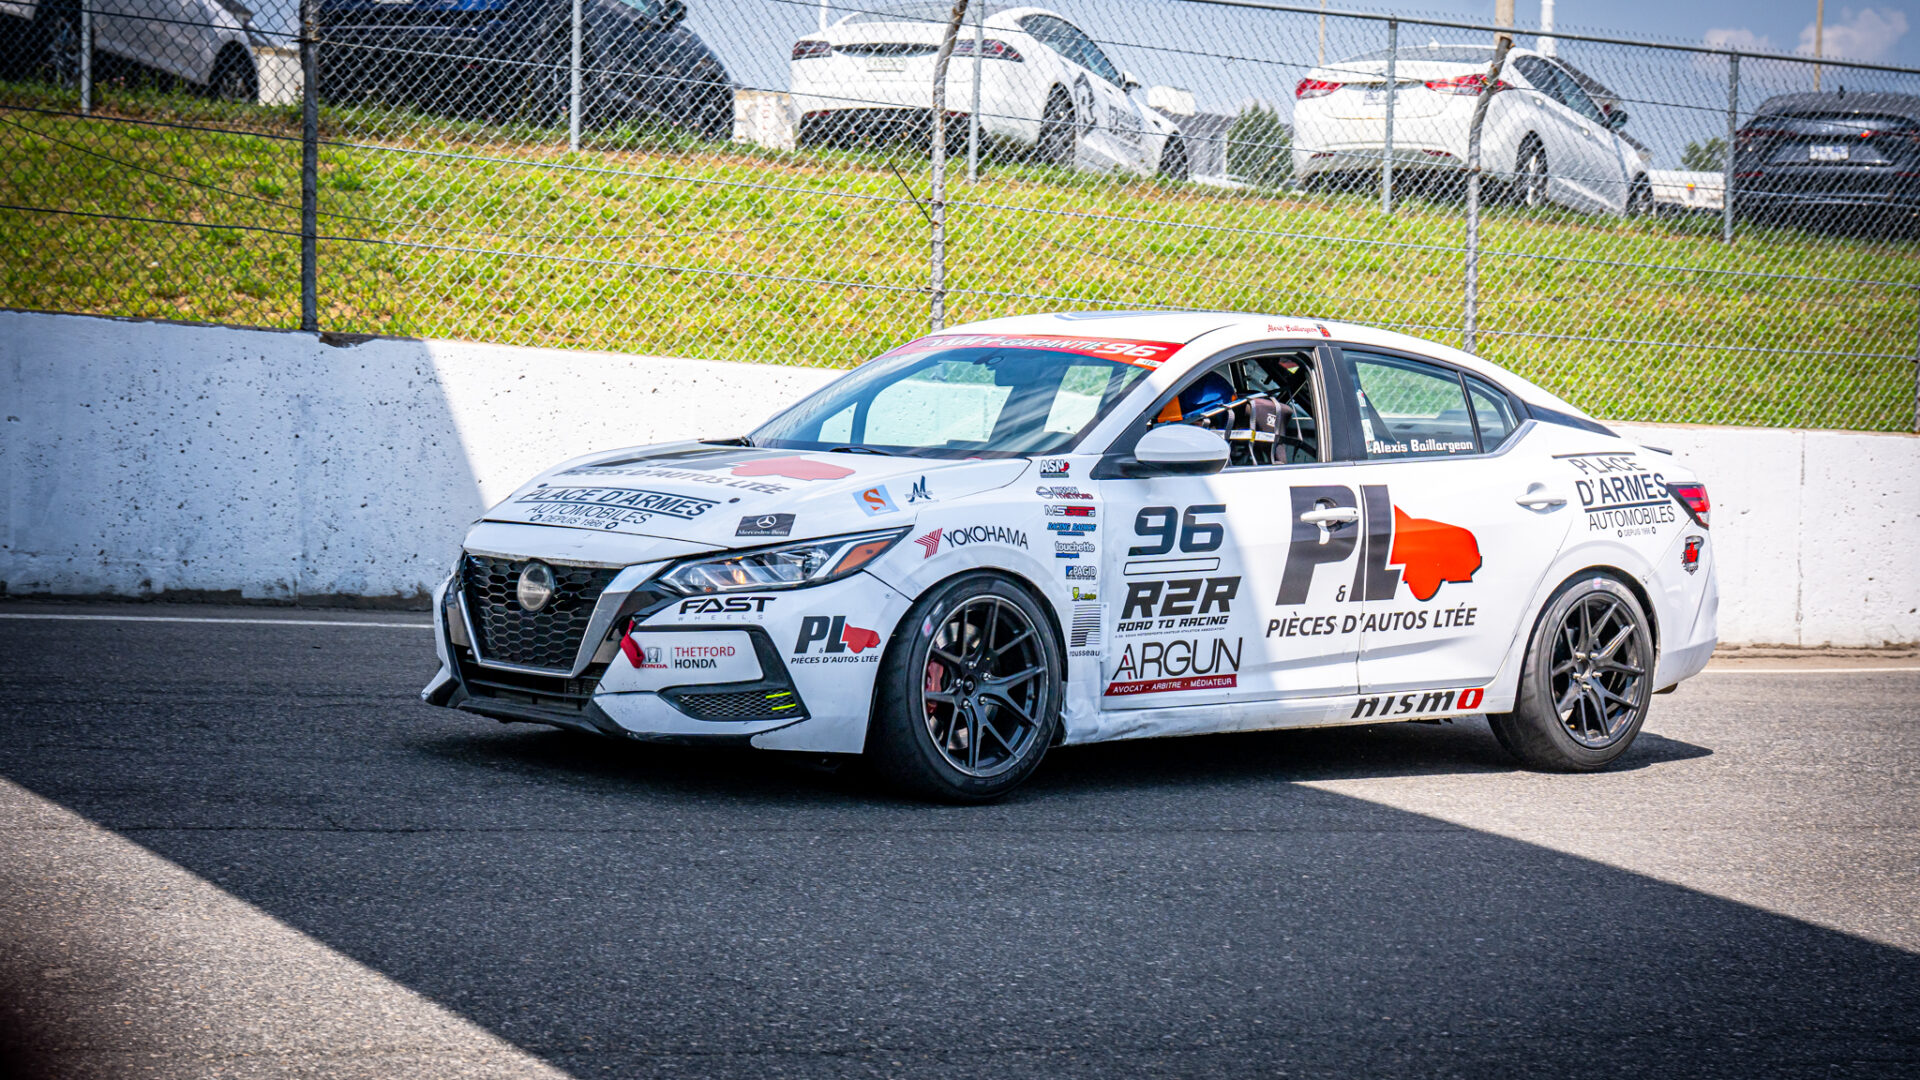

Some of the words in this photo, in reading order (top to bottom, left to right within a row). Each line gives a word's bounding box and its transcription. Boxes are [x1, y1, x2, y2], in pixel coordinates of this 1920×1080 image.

[1092, 343, 1168, 357] 96
[1372, 440, 1408, 454] Alexis
[1410, 439, 1474, 454] Baillargeon
[1040, 459, 1065, 473] ASN
[1568, 456, 1647, 475] PLACE
[626, 469, 731, 485] D'AUTOS
[725, 476, 791, 495] LTÉE
[1575, 473, 1669, 507] D'ARMES
[519, 489, 600, 501] PLACE
[596, 491, 713, 517] D'ARMES
[527, 503, 653, 525] AUTOMOBILES
[541, 515, 581, 524] DEPUIS
[1589, 506, 1675, 531] AUTOMOBILES
[942, 526, 1029, 550] YOKOHAMA
[1127, 504, 1226, 556] 96
[1055, 540, 1096, 552] touchette
[1073, 565, 1097, 577] PAGID
[679, 597, 777, 615] FAST
[1121, 576, 1242, 620] R2R
[1117, 620, 1153, 632] ROAD
[1158, 619, 1175, 629] TO
[1178, 615, 1229, 627] RACING
[1266, 611, 1337, 638] PIÈCES
[1341, 609, 1428, 634] D'AUTOS
[1433, 602, 1477, 629] LTÉE
[674, 646, 736, 657] THETFORD
[791, 655, 820, 664] PIÈCES
[822, 655, 859, 664] D'AUTOS
[861, 653, 879, 663] LTÉE
[1112, 637, 1243, 680] ARGUN
[674, 658, 717, 669] HONDA
[1113, 684, 1144, 694] AVOCAT
[1151, 681, 1182, 691] ARBITRE
[1190, 677, 1232, 687] MÉDIATEUR
